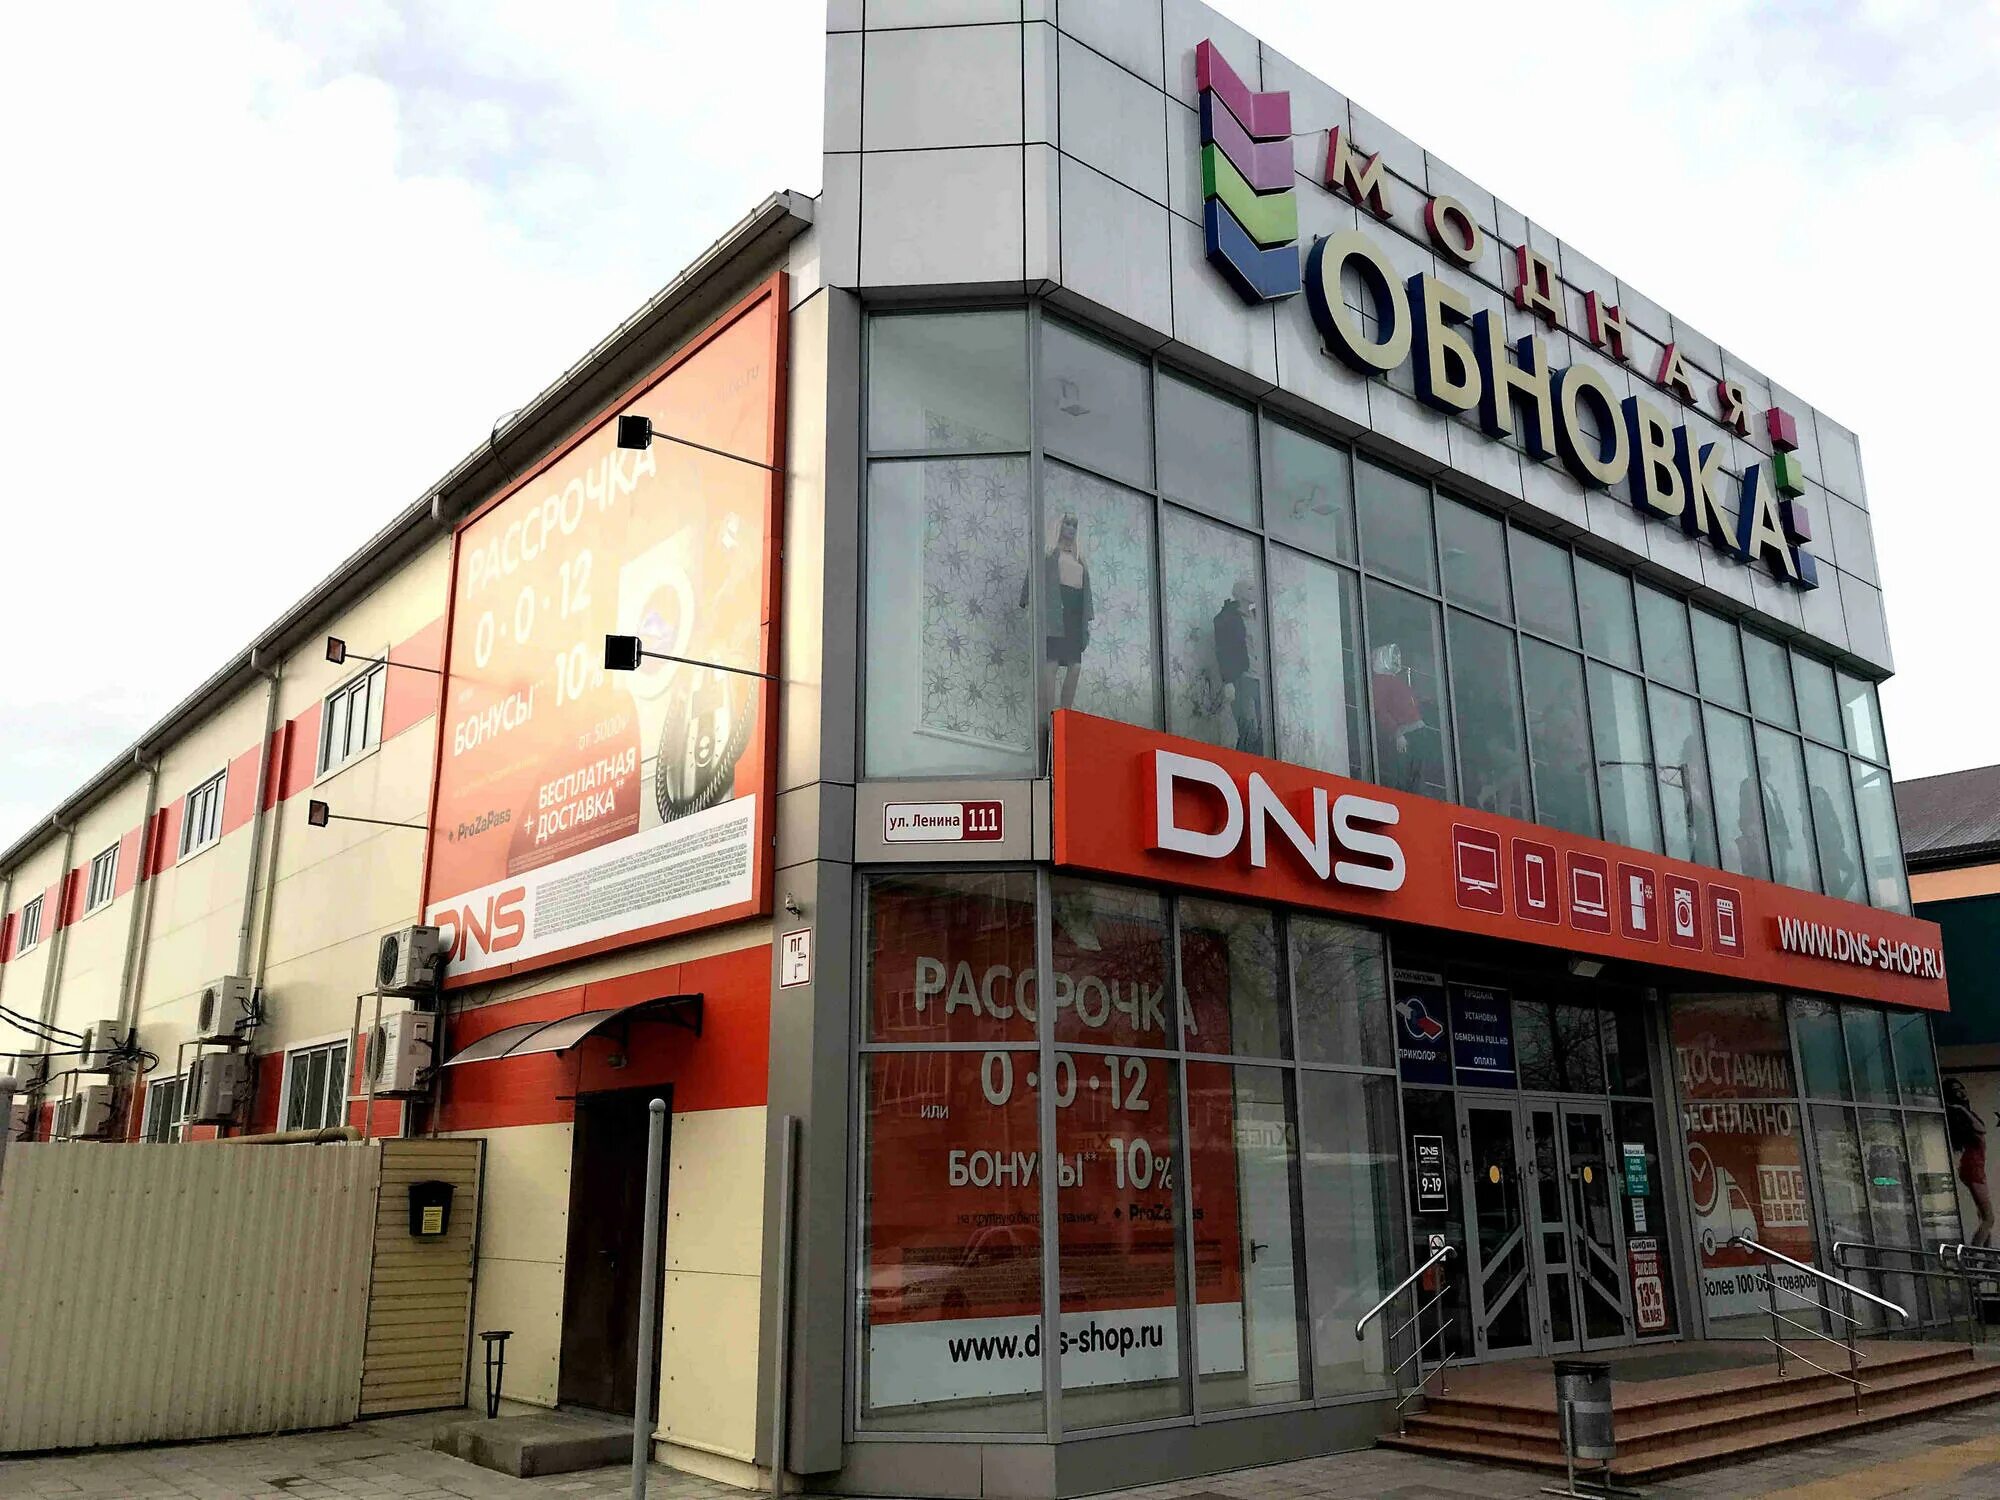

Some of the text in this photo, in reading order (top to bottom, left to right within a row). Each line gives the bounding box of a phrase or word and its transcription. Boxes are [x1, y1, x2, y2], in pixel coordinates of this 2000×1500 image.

[1326, 125, 1752, 436] МОДНАЯ
[1306, 229, 1801, 584] ОБНОВКА
[466, 447, 657, 600] РАССРОЧКА
[538, 746, 637, 810] БЕСПЛАТНАЯ
[457, 807, 512, 842] ProZaPass
[889, 808, 999, 832] ул. Ленина 111
[1146, 749, 1406, 893] DNS
[433, 886, 526, 966] DNS
[790, 937, 803, 953] ПГ
[1776, 915, 1946, 980] WWW.DNS-SHOP.RU
[1473, 1056, 1497, 1067] ОПЛАТА
[949, 1149, 1098, 1188] БОНУЫ
[1419, 1146, 1439, 1156] DNS
[1421, 1177, 1442, 1192] 9-19
[1637, 1282, 1660, 1307] 13%
[1735, 1273, 1754, 1294] 100
[948, 1321, 1164, 1363] www.ds-shop.ru
